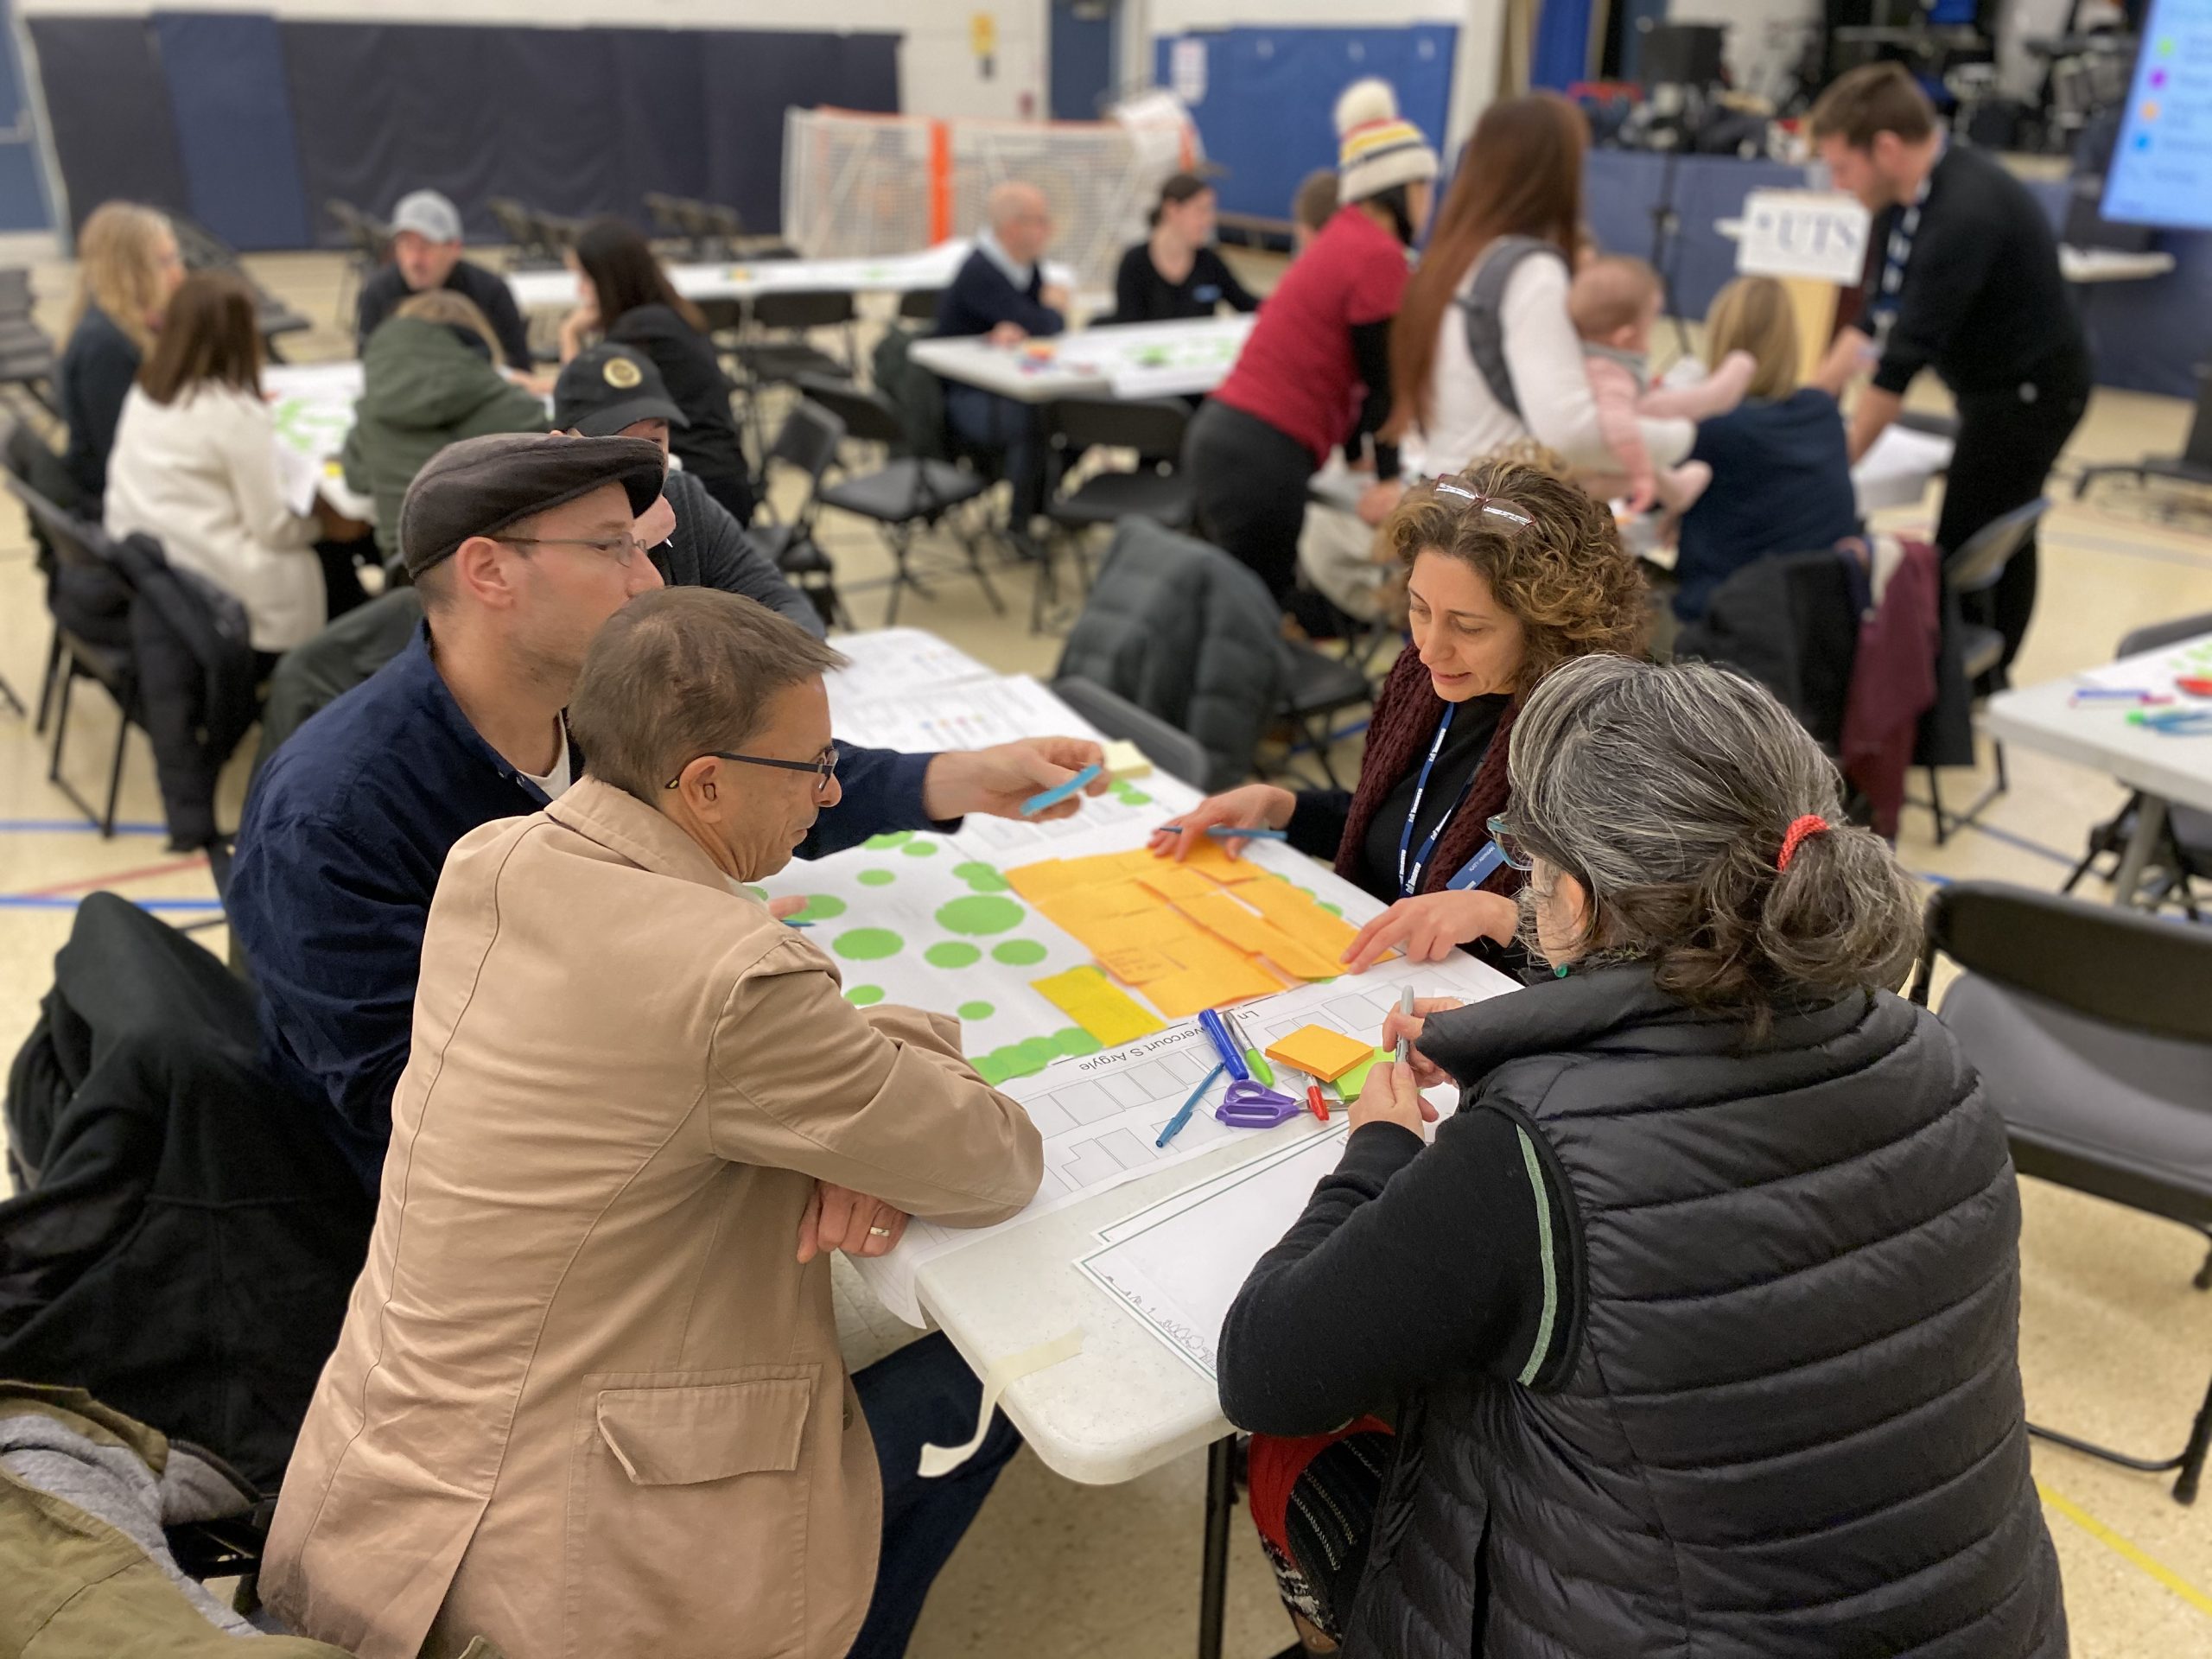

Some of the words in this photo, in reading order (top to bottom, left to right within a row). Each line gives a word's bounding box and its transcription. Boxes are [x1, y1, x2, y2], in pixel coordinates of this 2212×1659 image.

[1236, 1010, 1260, 1020] Ln
[1145, 1026, 1205, 1052] vercourt
[1129, 1047, 1145, 1058] S
[1078, 1053, 1127, 1071] Argyle
